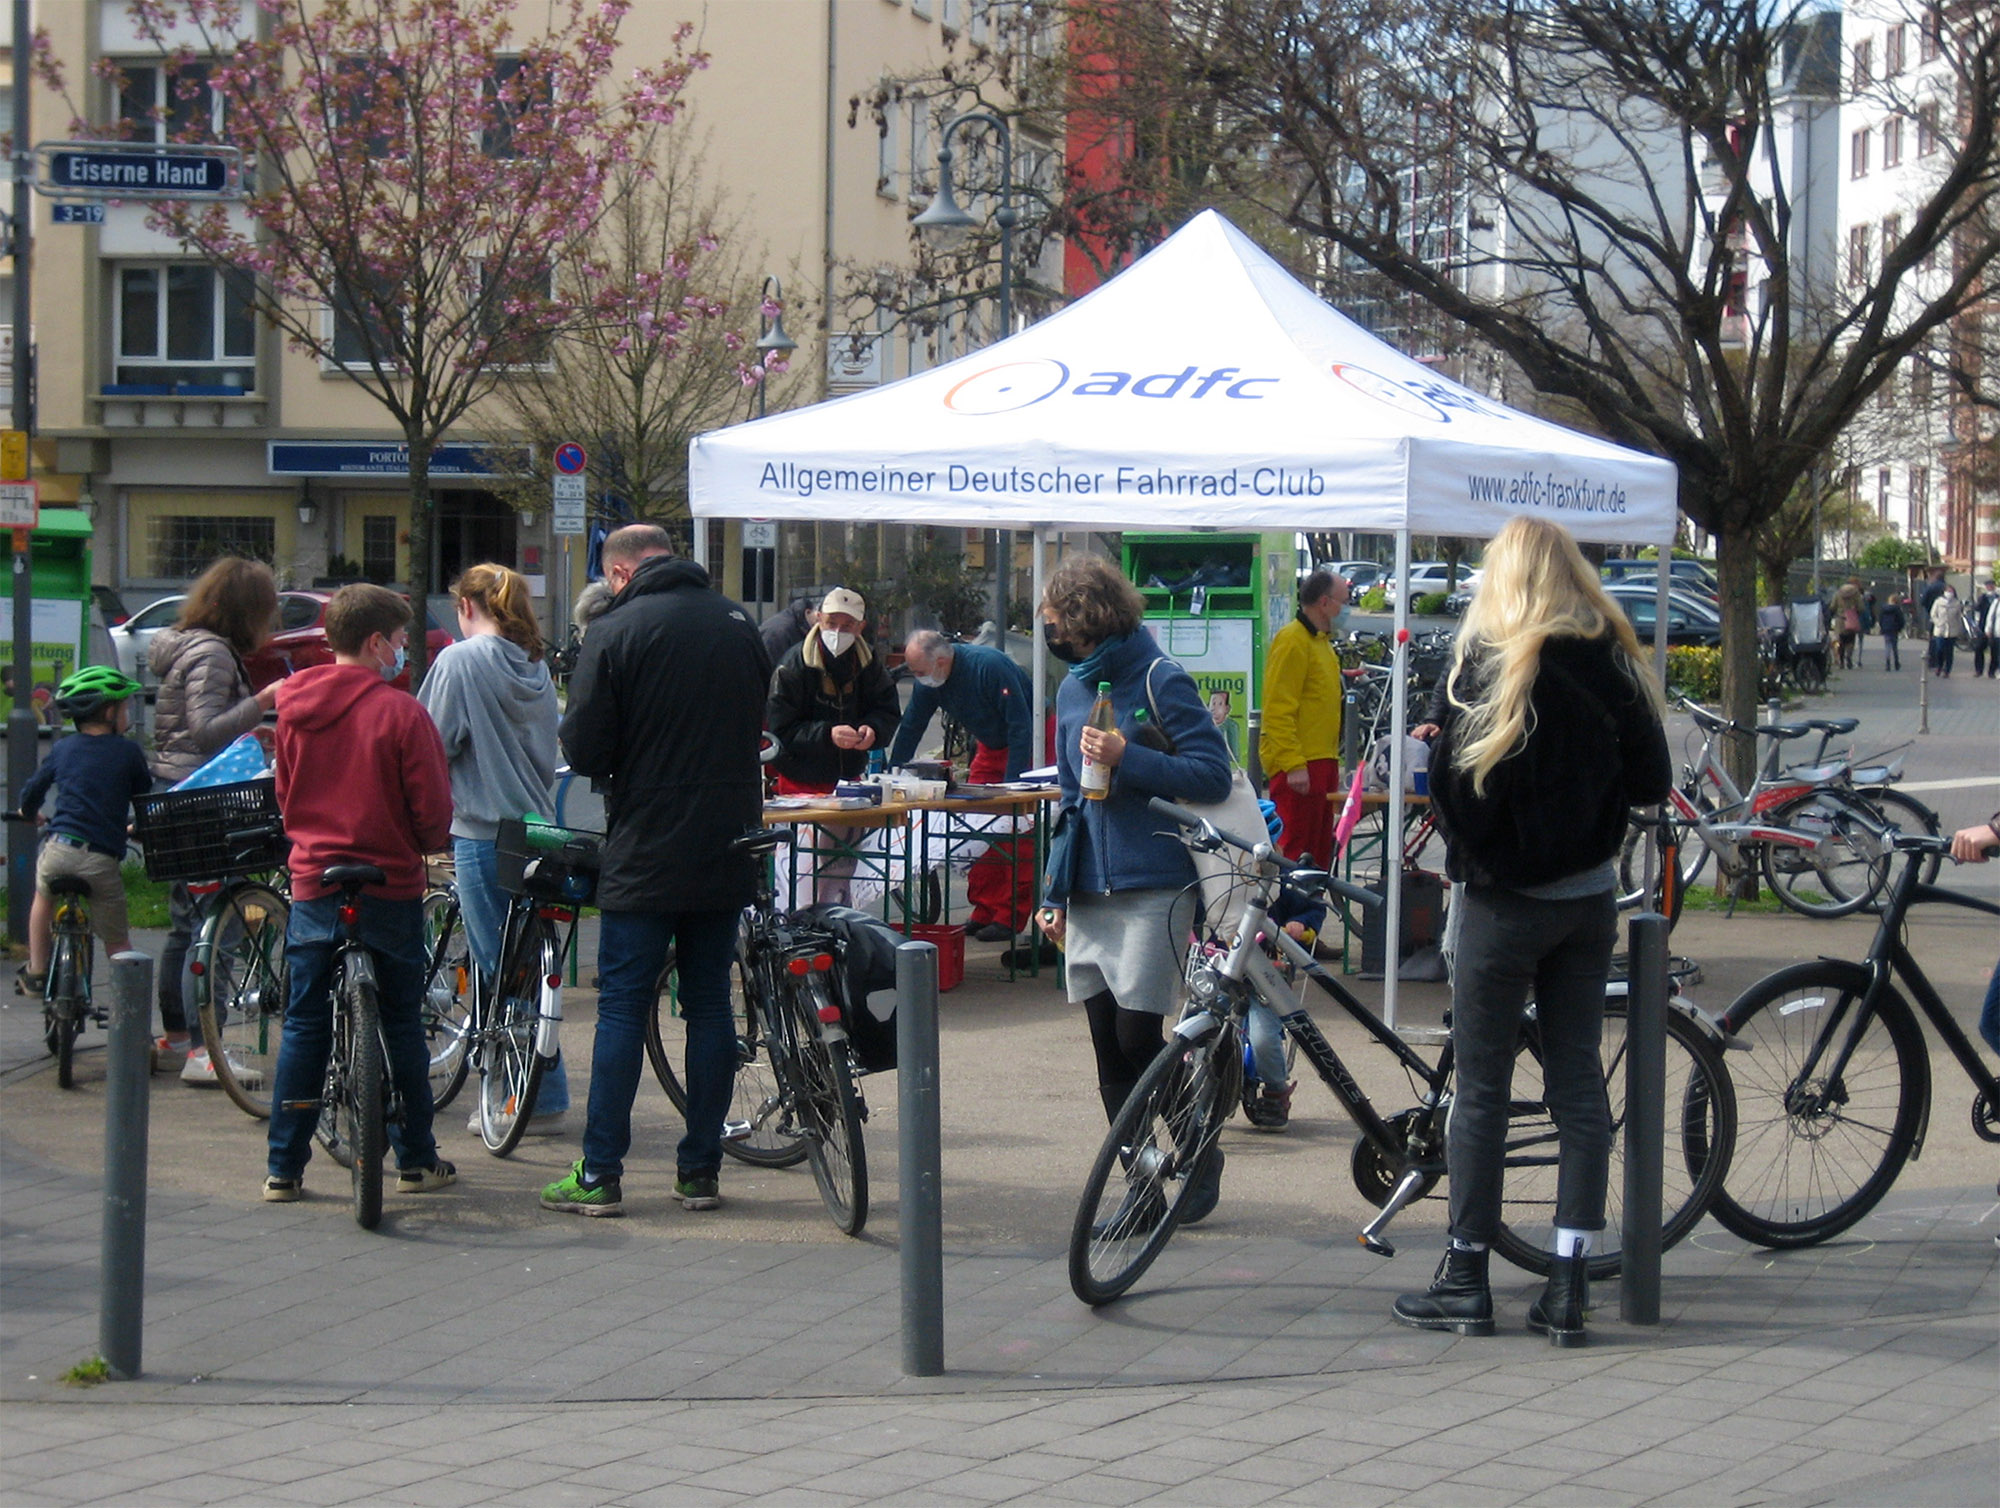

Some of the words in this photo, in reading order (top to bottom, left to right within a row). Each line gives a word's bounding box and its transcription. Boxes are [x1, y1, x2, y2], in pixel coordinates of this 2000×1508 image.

[69, 157, 148, 183] Eiserne
[156, 160, 208, 185] Hand
[63, 206, 104, 221] 3-19
[1072, 366, 1280, 399] adfc
[759, 461, 936, 497] Allgemeiner
[949, 464, 1104, 494] Deutscher
[1117, 467, 1325, 496] Fahrrad-Club
[1468, 471, 1626, 514] www.adfc-frankfurt.de
[1196, 676, 1245, 695] rtung
